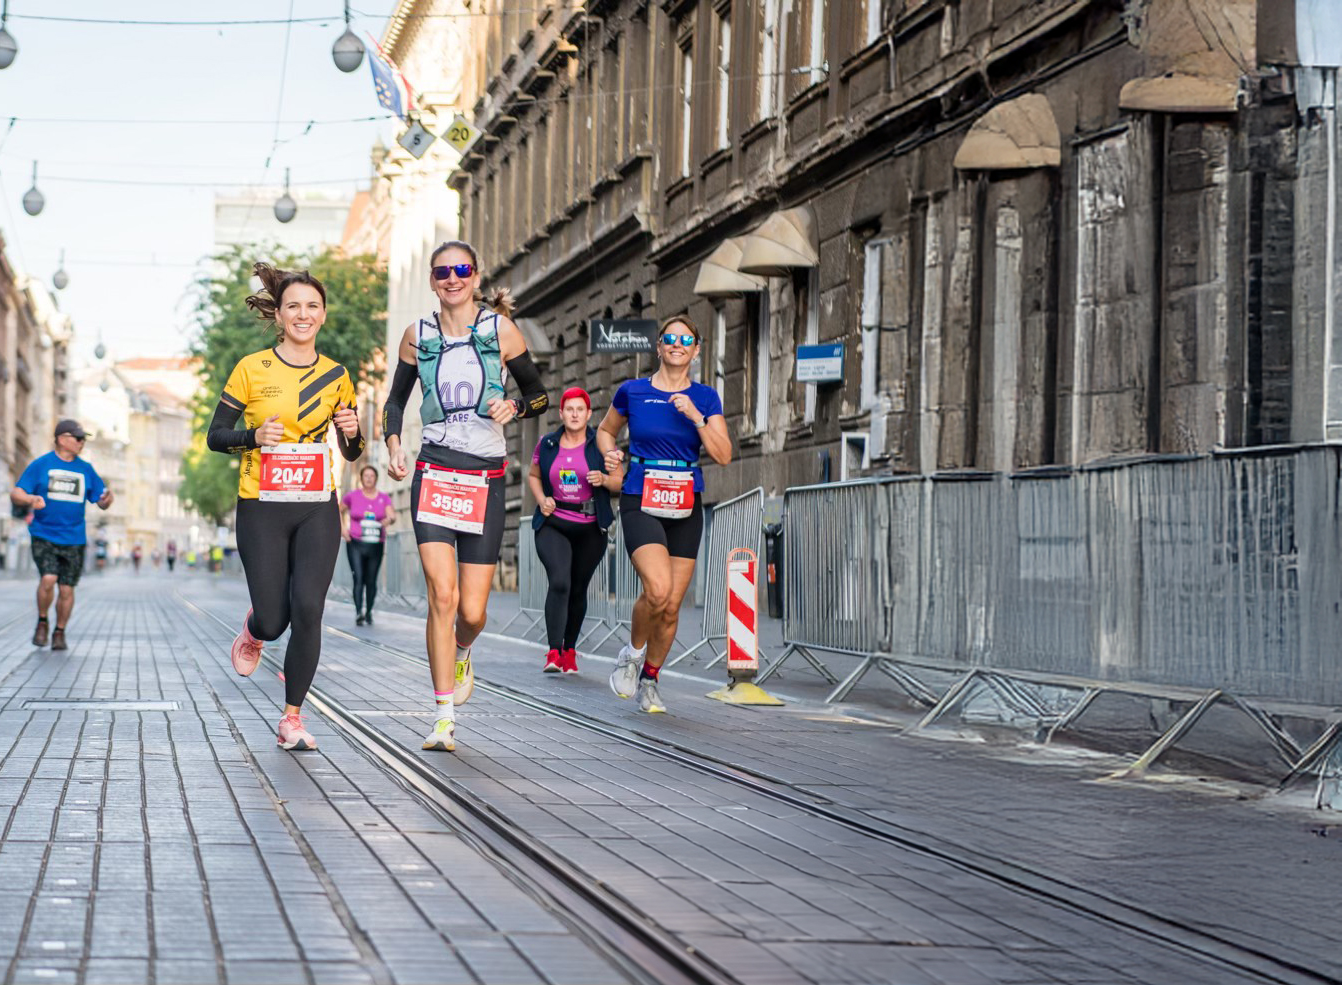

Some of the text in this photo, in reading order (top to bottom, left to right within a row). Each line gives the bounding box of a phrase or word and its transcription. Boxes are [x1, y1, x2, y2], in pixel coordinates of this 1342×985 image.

[452, 128, 469, 141] 20
[439, 381, 474, 410] 40
[445, 413, 469, 424] EARS
[271, 467, 314, 485] 2047
[431, 493, 474, 515] 3596
[651, 489, 685, 504] 3081
